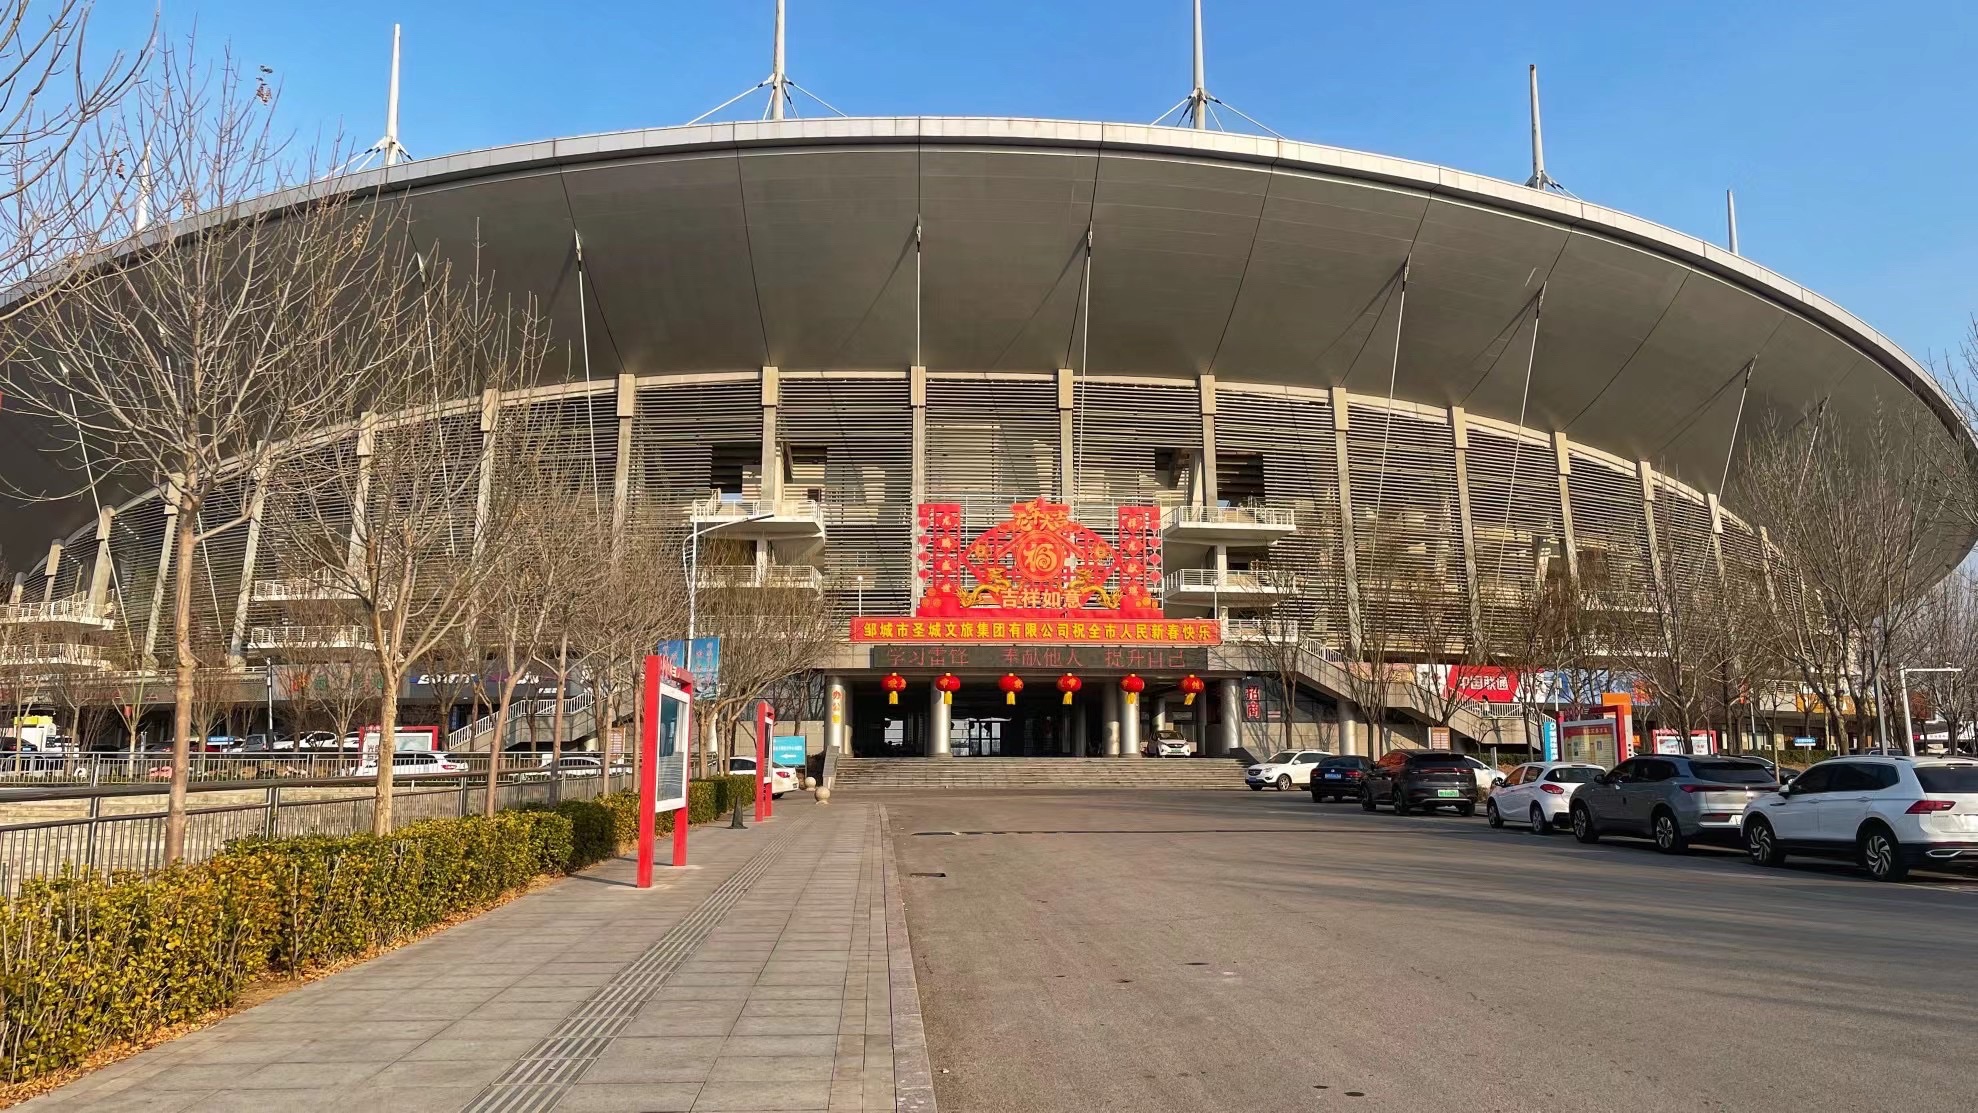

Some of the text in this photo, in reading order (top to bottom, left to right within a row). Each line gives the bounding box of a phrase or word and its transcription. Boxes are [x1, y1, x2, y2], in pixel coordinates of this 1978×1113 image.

[1014, 500, 1070, 532] 龙年大吉
[1023, 543, 1058, 573] 福
[1001, 587, 1082, 609] 吉祥如意
[863, 621, 1211, 641] 邹城市圣城文旅集团有限公司祝全市人民新春快乐
[1000, 647, 1083, 668] 奉献他人
[1459, 675, 1509, 691] 中国联通
[1245, 687, 1261, 719] 招商
